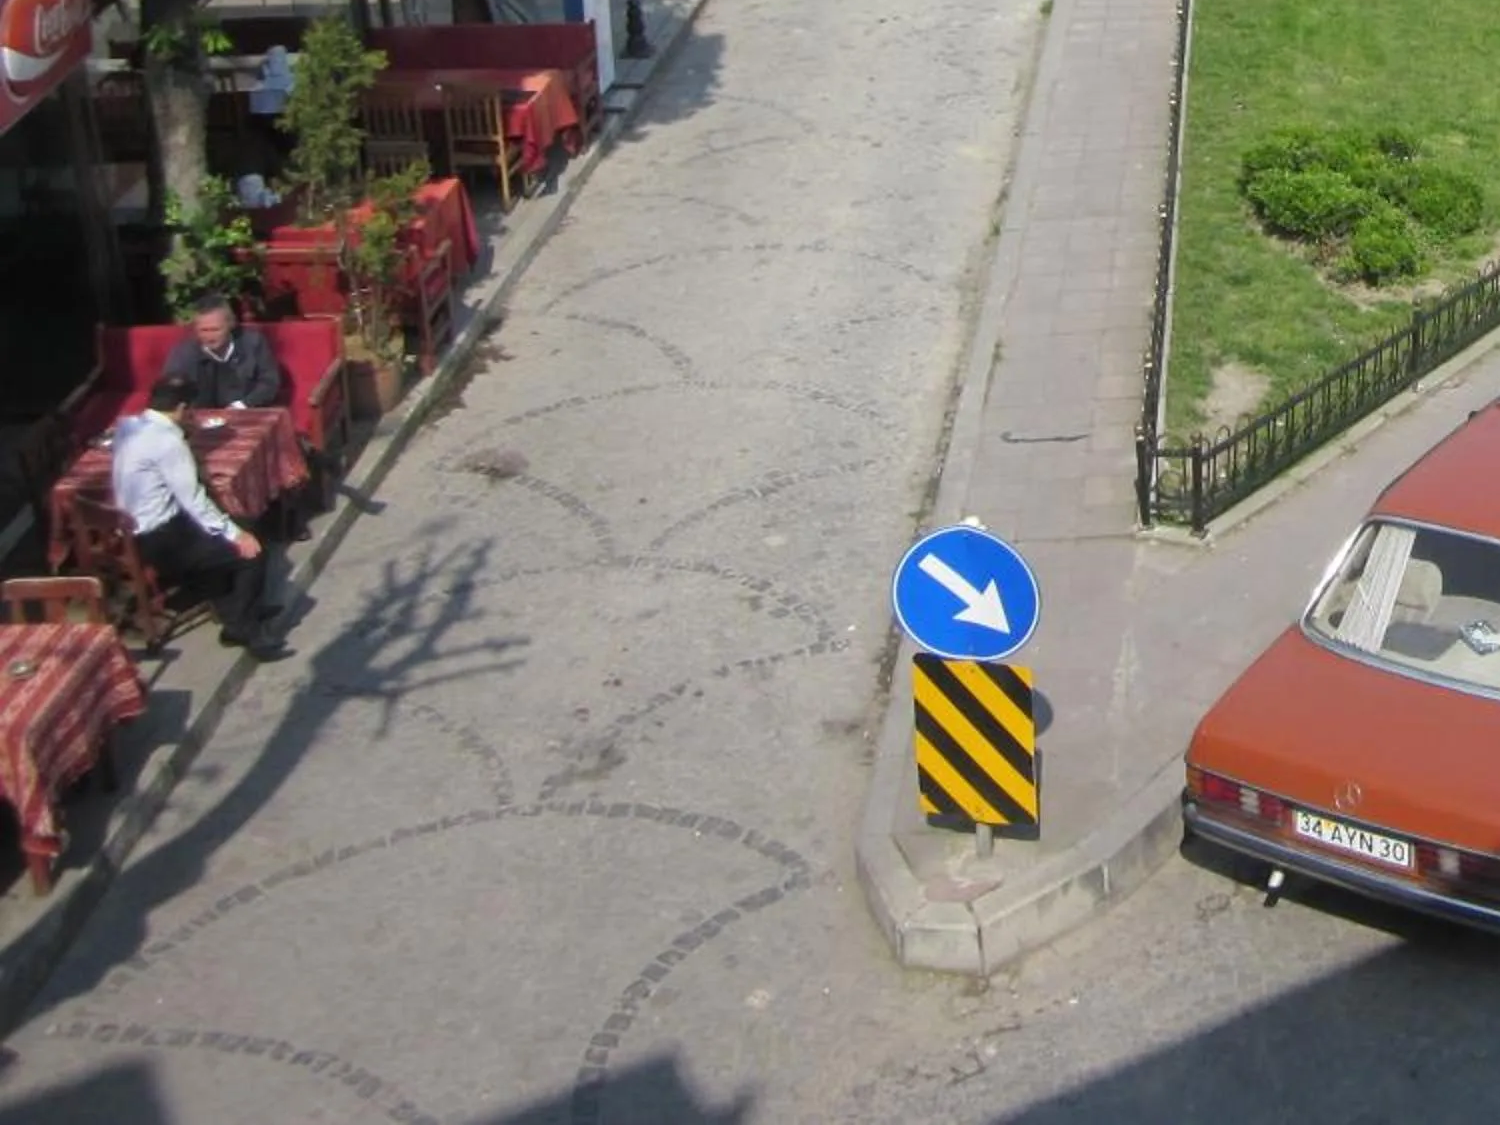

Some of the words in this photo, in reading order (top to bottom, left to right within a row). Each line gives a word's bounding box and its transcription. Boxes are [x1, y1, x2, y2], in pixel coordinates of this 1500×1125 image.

[1300, 811, 1323, 836] 34
[1331, 824, 1374, 854] AYN
[1379, 838, 1405, 862] 30
